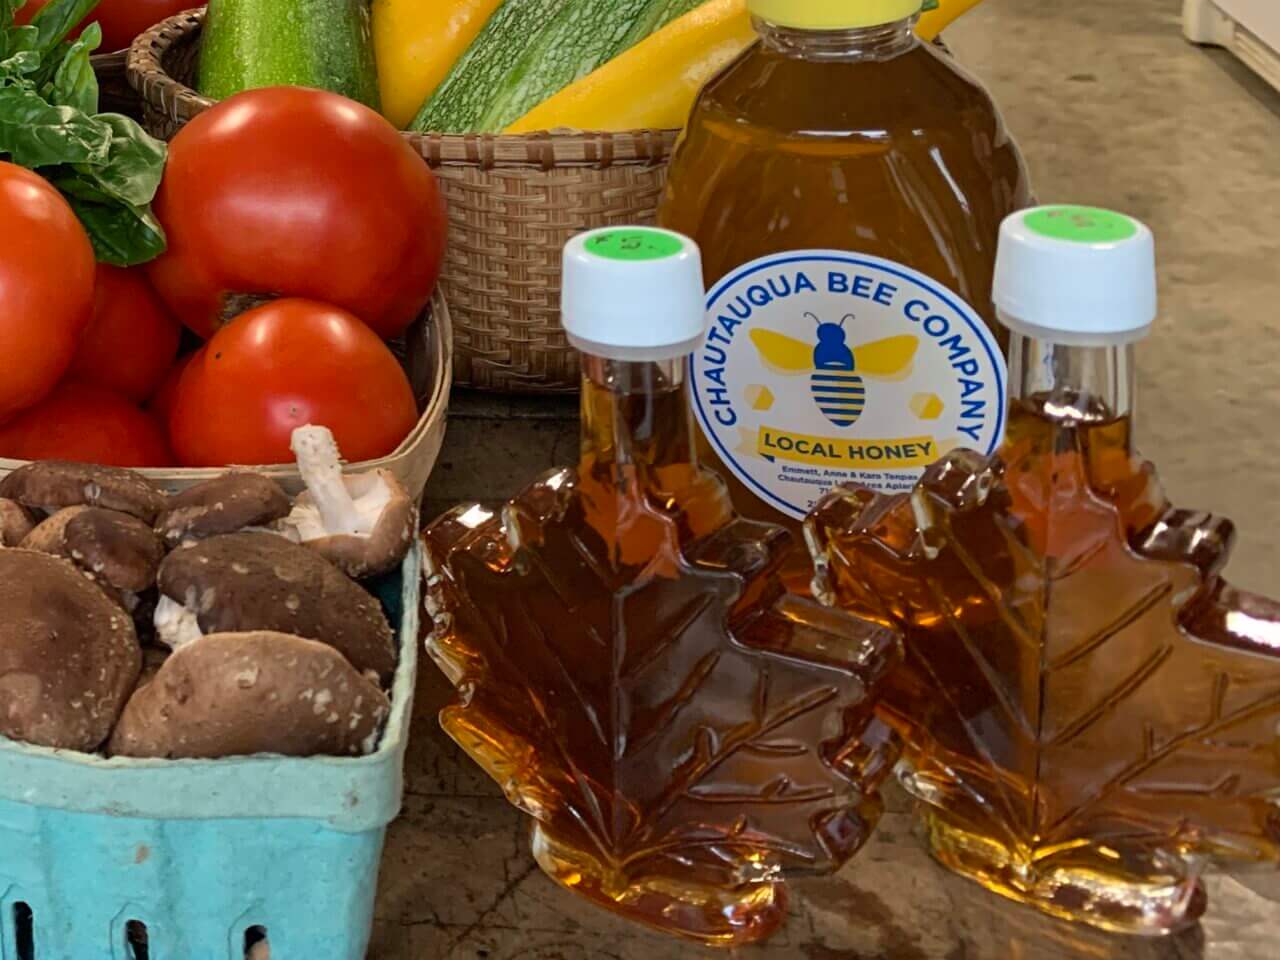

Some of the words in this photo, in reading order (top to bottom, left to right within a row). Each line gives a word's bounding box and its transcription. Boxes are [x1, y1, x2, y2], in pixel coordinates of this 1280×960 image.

[703, 271, 818, 427] CHAUTAUQUA
[827, 271, 899, 307] BEE
[903, 299, 986, 442] COMPANY
[764, 433, 842, 460] LOCAL
[849, 441, 933, 461] HONEY
